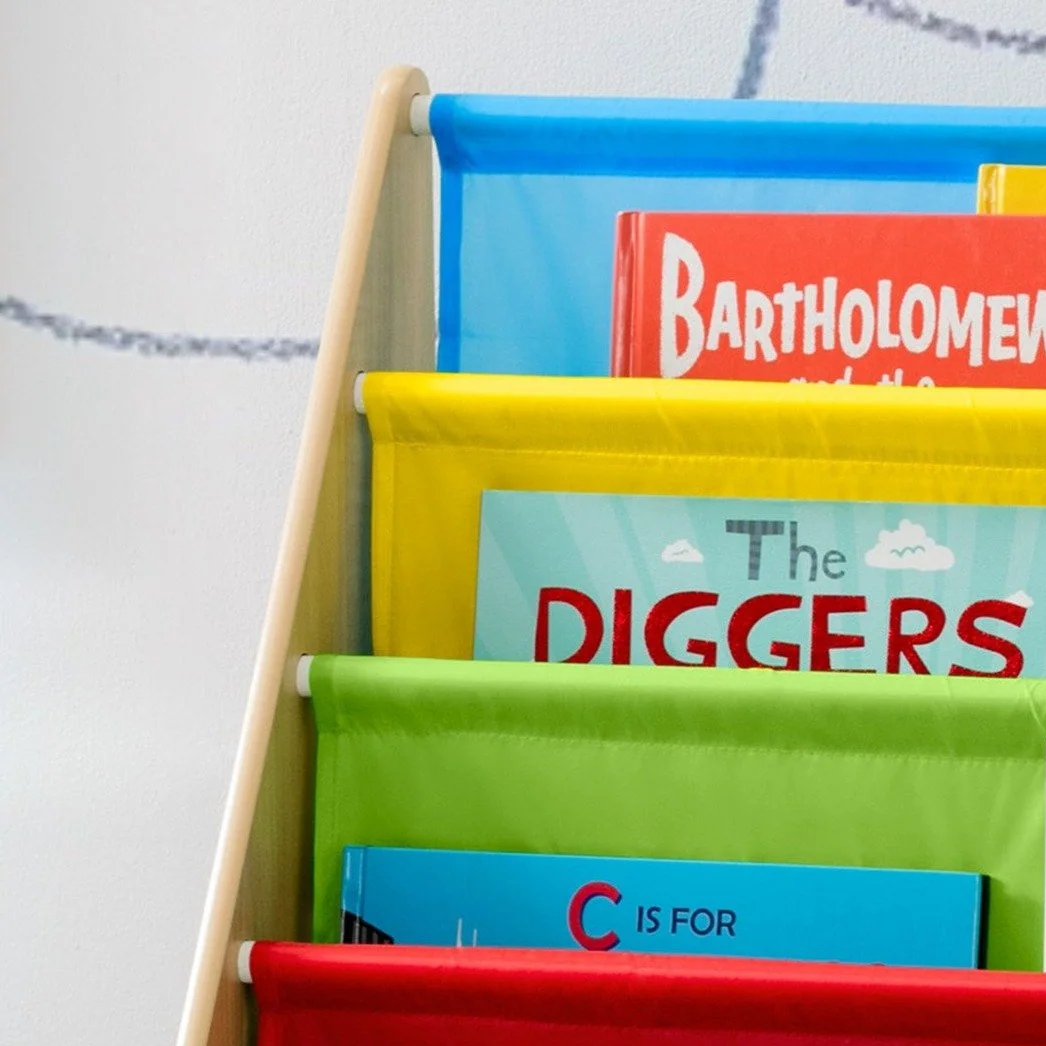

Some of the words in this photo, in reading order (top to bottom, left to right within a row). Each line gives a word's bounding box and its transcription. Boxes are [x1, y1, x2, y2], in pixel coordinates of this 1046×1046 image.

[725, 520, 847, 582] The
[533, 587, 1028, 679] DIGGERS
[567, 880, 623, 951] C
[637, 906, 662, 933] IS
[671, 907, 736, 937] FOR
